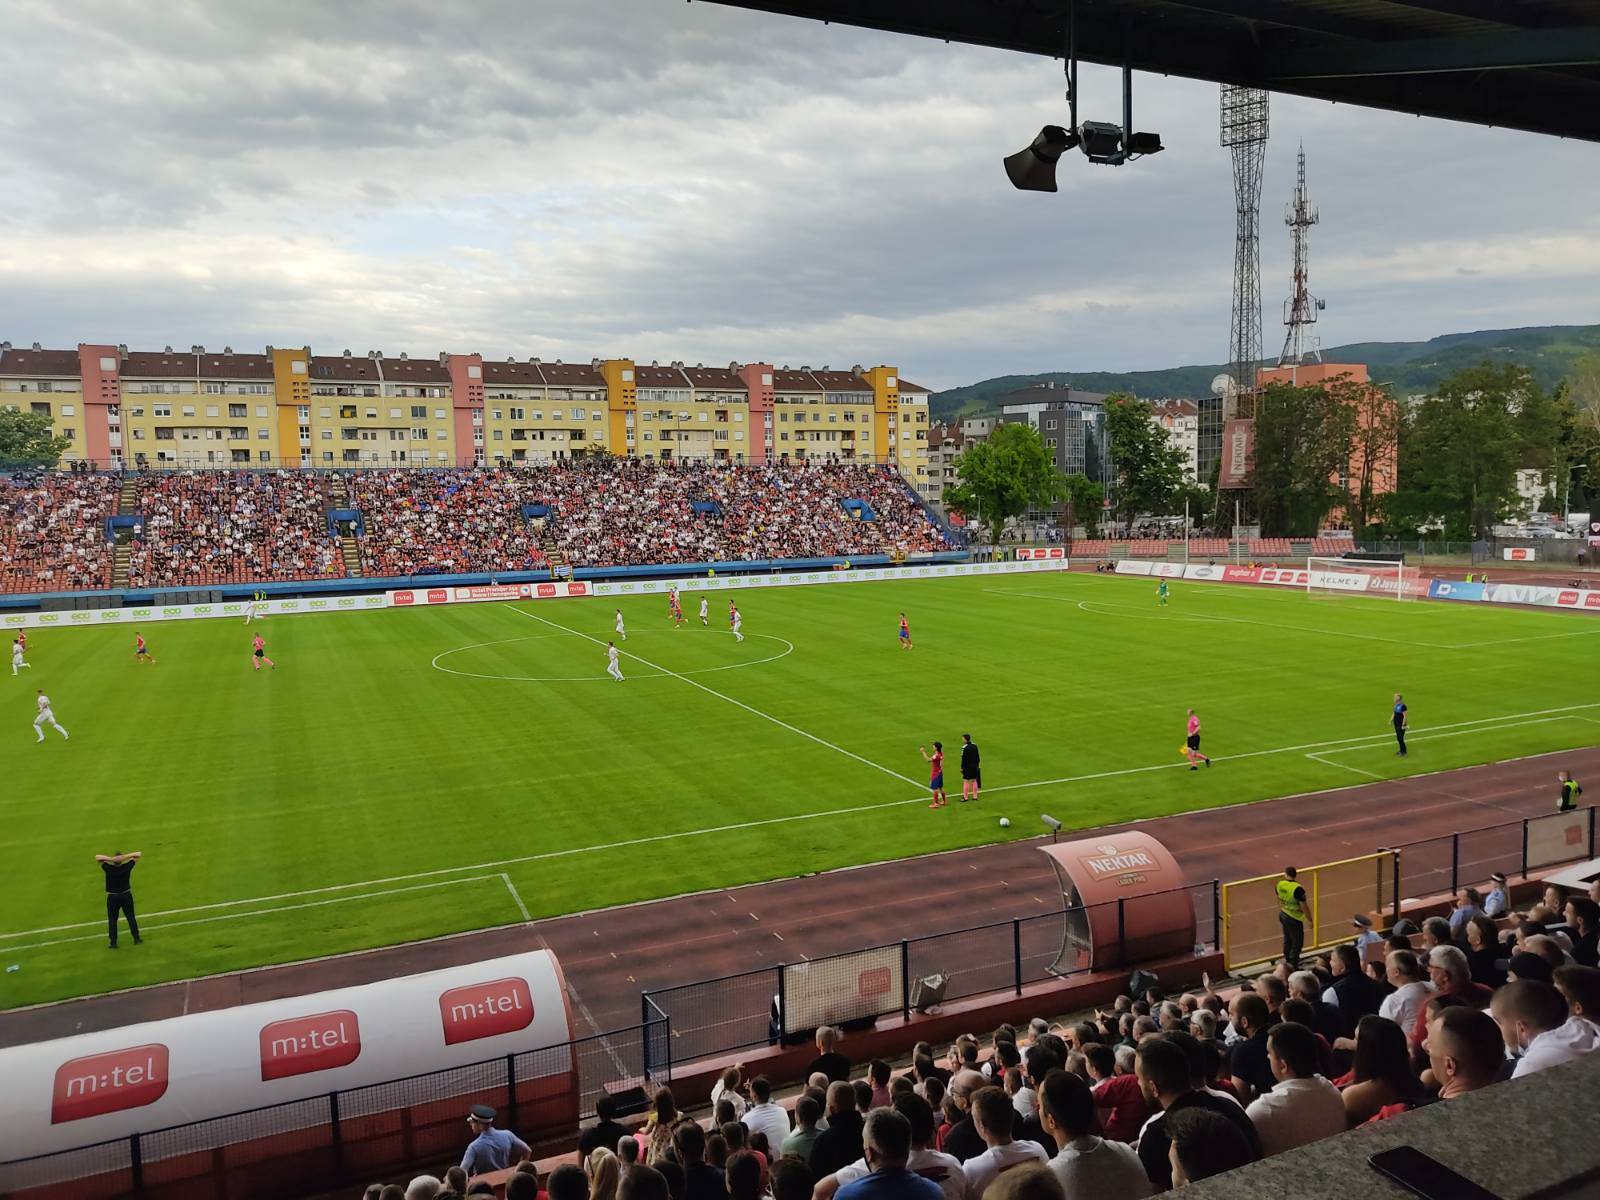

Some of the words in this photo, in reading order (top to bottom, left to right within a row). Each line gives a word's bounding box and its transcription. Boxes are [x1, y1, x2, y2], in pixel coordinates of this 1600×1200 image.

[1088, 853, 1152, 874] NEKTAR
[450, 988, 523, 1024] m:tel
[270, 1022, 350, 1058] m:tel
[65, 1056, 156, 1100] m:tel
